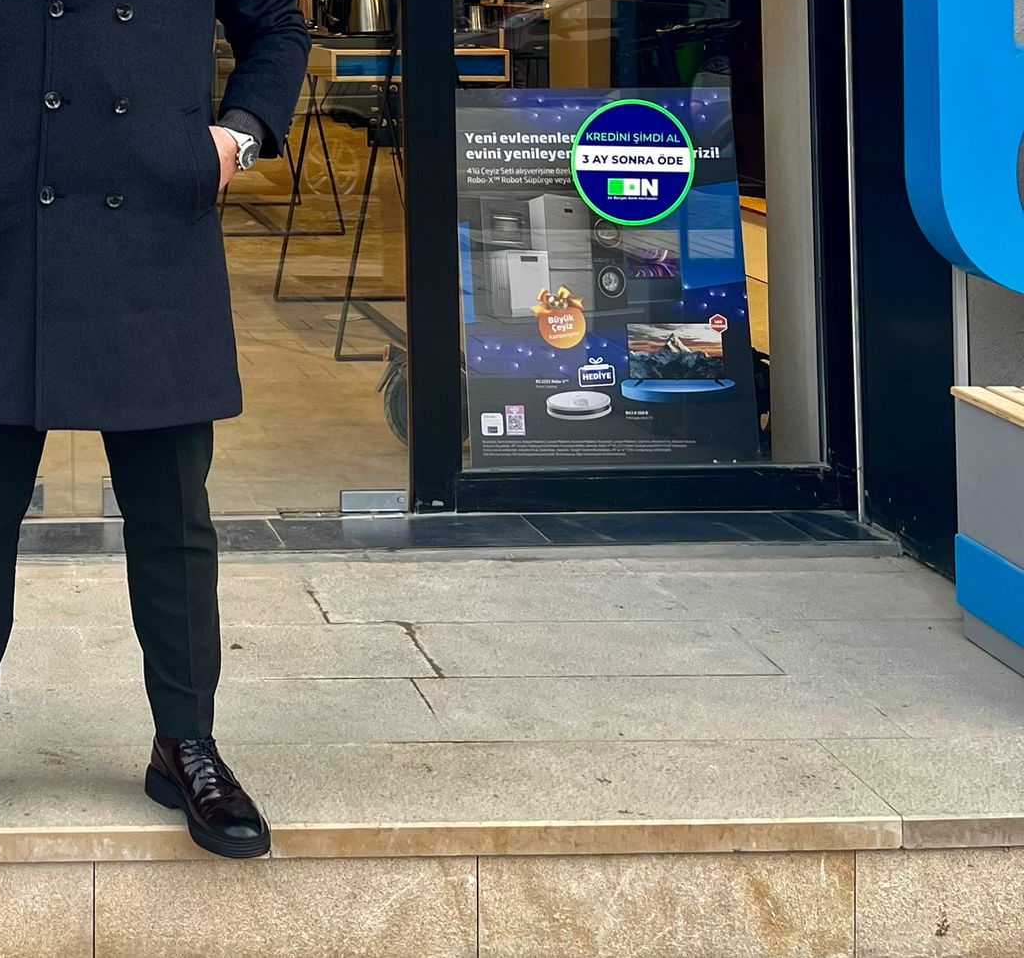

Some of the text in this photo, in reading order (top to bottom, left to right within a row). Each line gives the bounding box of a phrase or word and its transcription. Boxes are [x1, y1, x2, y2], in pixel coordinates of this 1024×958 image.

[464, 132, 497, 144] Yeni
[586, 131, 681, 144] KREDİNİ ŞİMDİ AL
[465, 147, 501, 160] evini
[693, 146, 720, 159] rizi!
[582, 153, 684, 166] 3 AY SONRA ÖDE
[501, 176, 523, 184] Robot
[547, 314, 575, 325] Büyük
[551, 323, 574, 333] Çeyiz
[582, 371, 612, 381] HEDİYE
